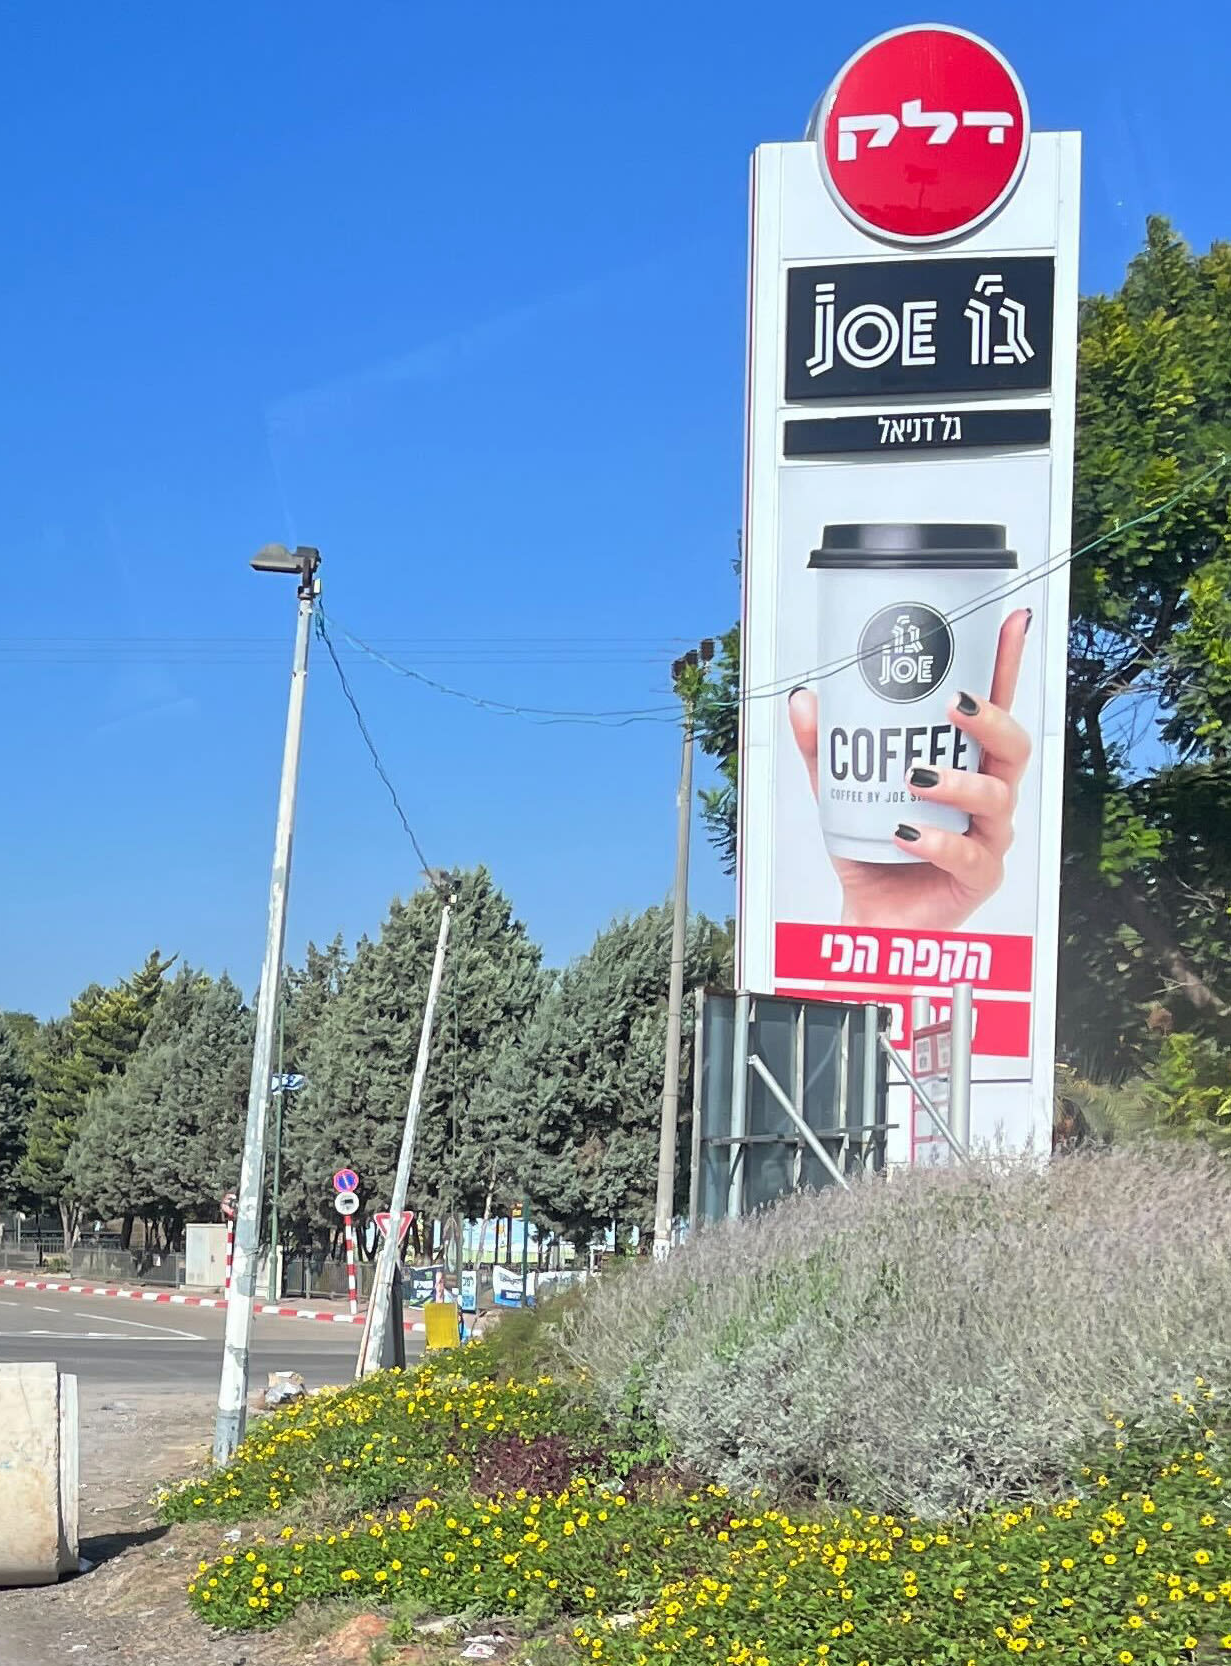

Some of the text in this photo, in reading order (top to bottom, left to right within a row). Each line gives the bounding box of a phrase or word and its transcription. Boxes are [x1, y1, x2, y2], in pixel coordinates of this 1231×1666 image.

[838, 99, 1014, 161] דלק
[878, 414, 961, 443] גל דניאל
[878, 650, 933, 686] JOE
[831, 788, 863, 802] COFFEE
[868, 791, 880, 802] BY
[886, 791, 905, 803] JOE
[821, 933, 992, 983] הקפה הכי
